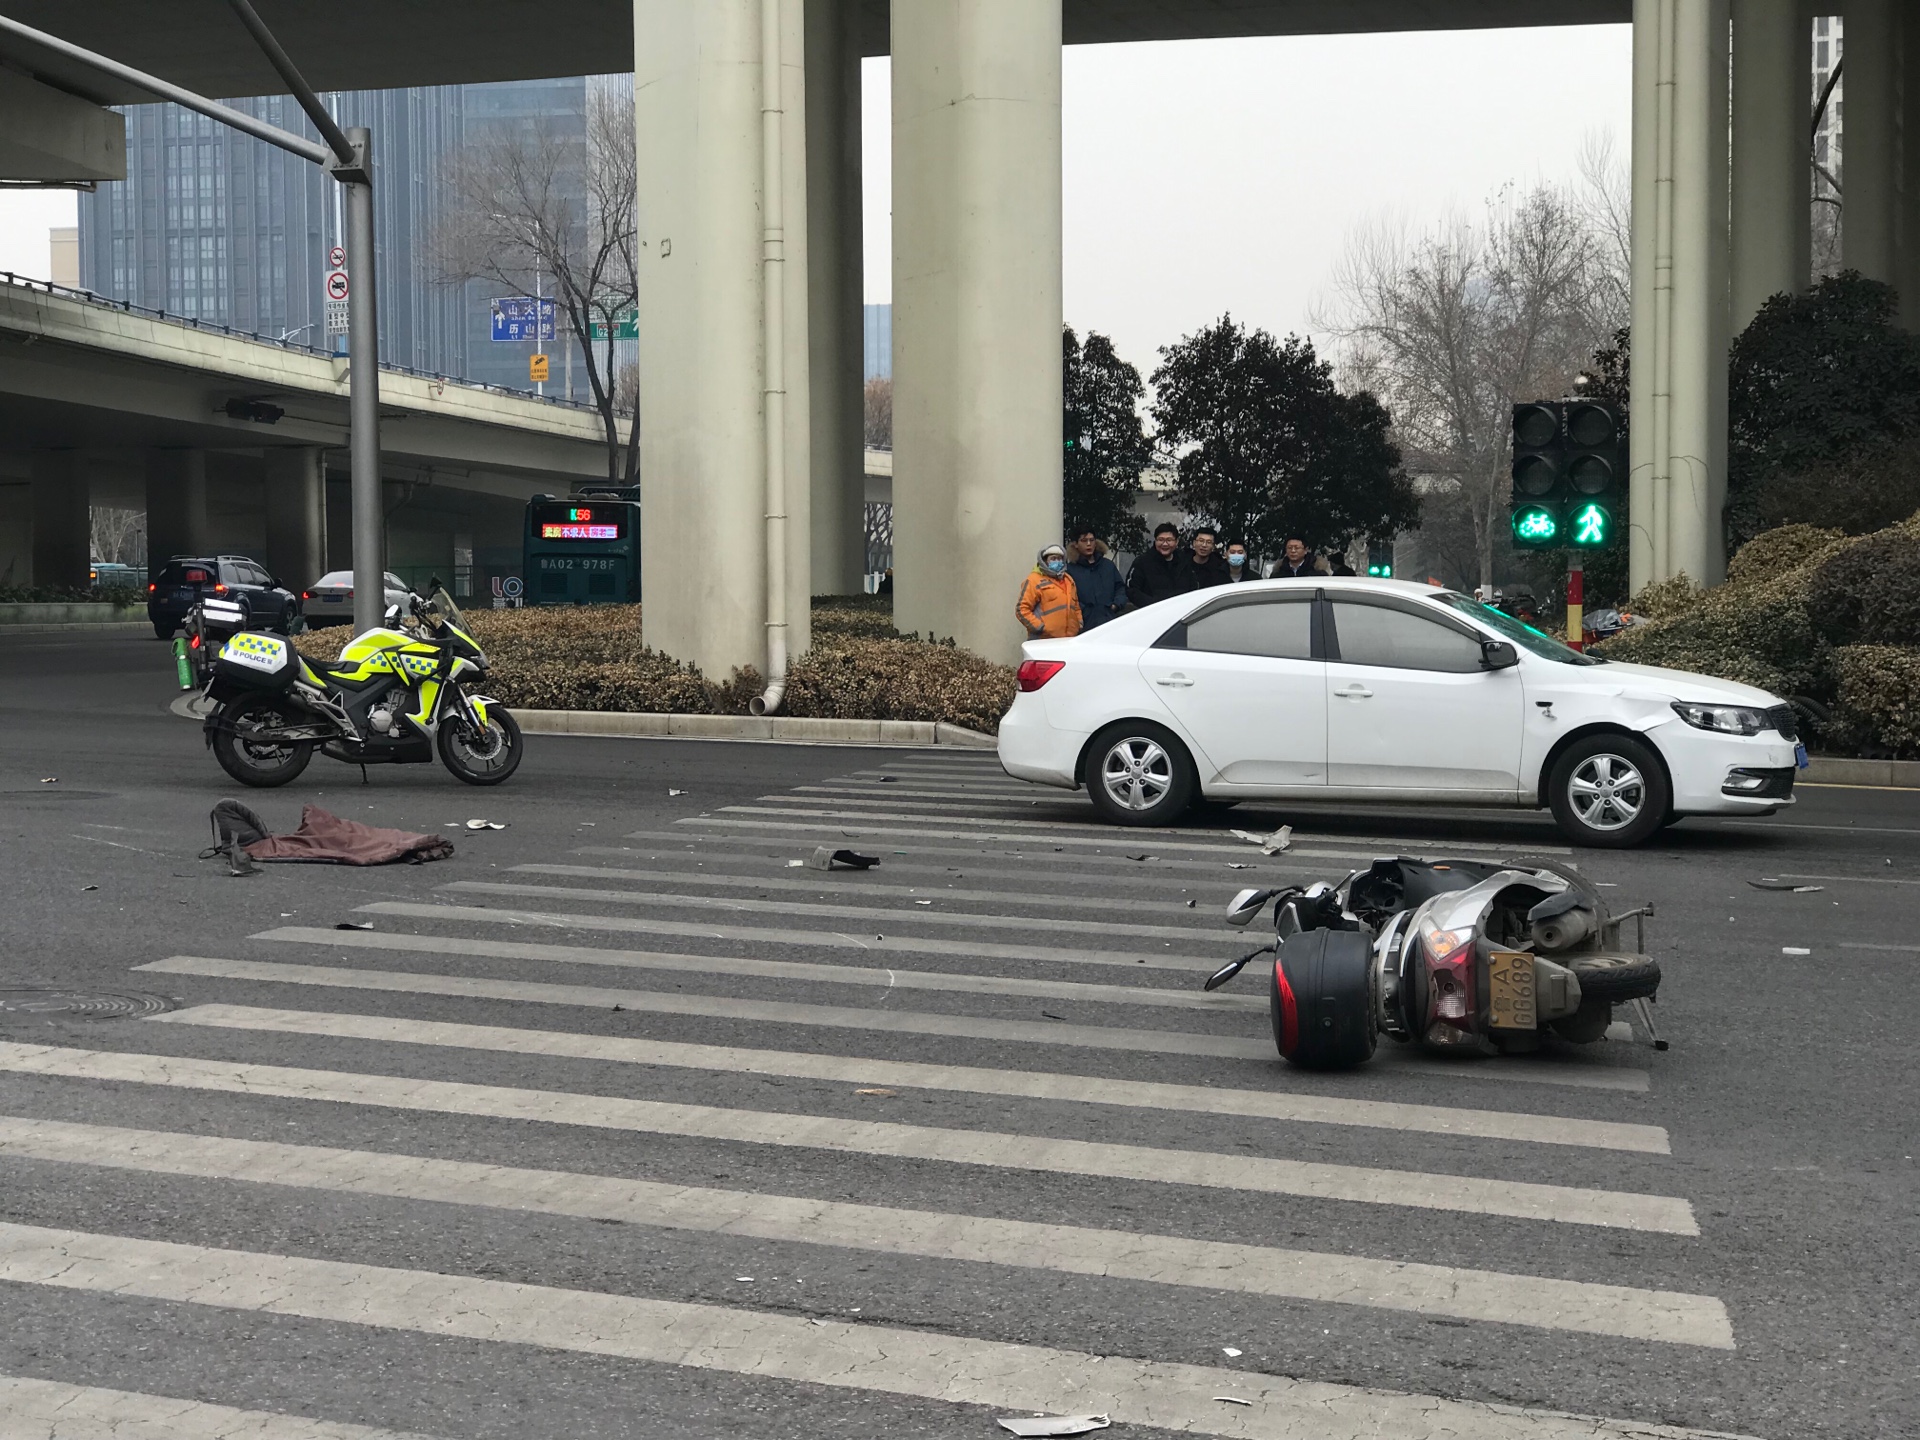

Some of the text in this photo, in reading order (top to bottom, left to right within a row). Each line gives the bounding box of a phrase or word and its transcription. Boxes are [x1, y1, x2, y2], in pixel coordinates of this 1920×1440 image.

[508, 304, 552, 315] 山大路
[509, 323, 552, 334] 历山路
[598, 328, 620, 337] G201
[570, 508, 591, 521] K56
[239, 652, 267, 663] POLICE
